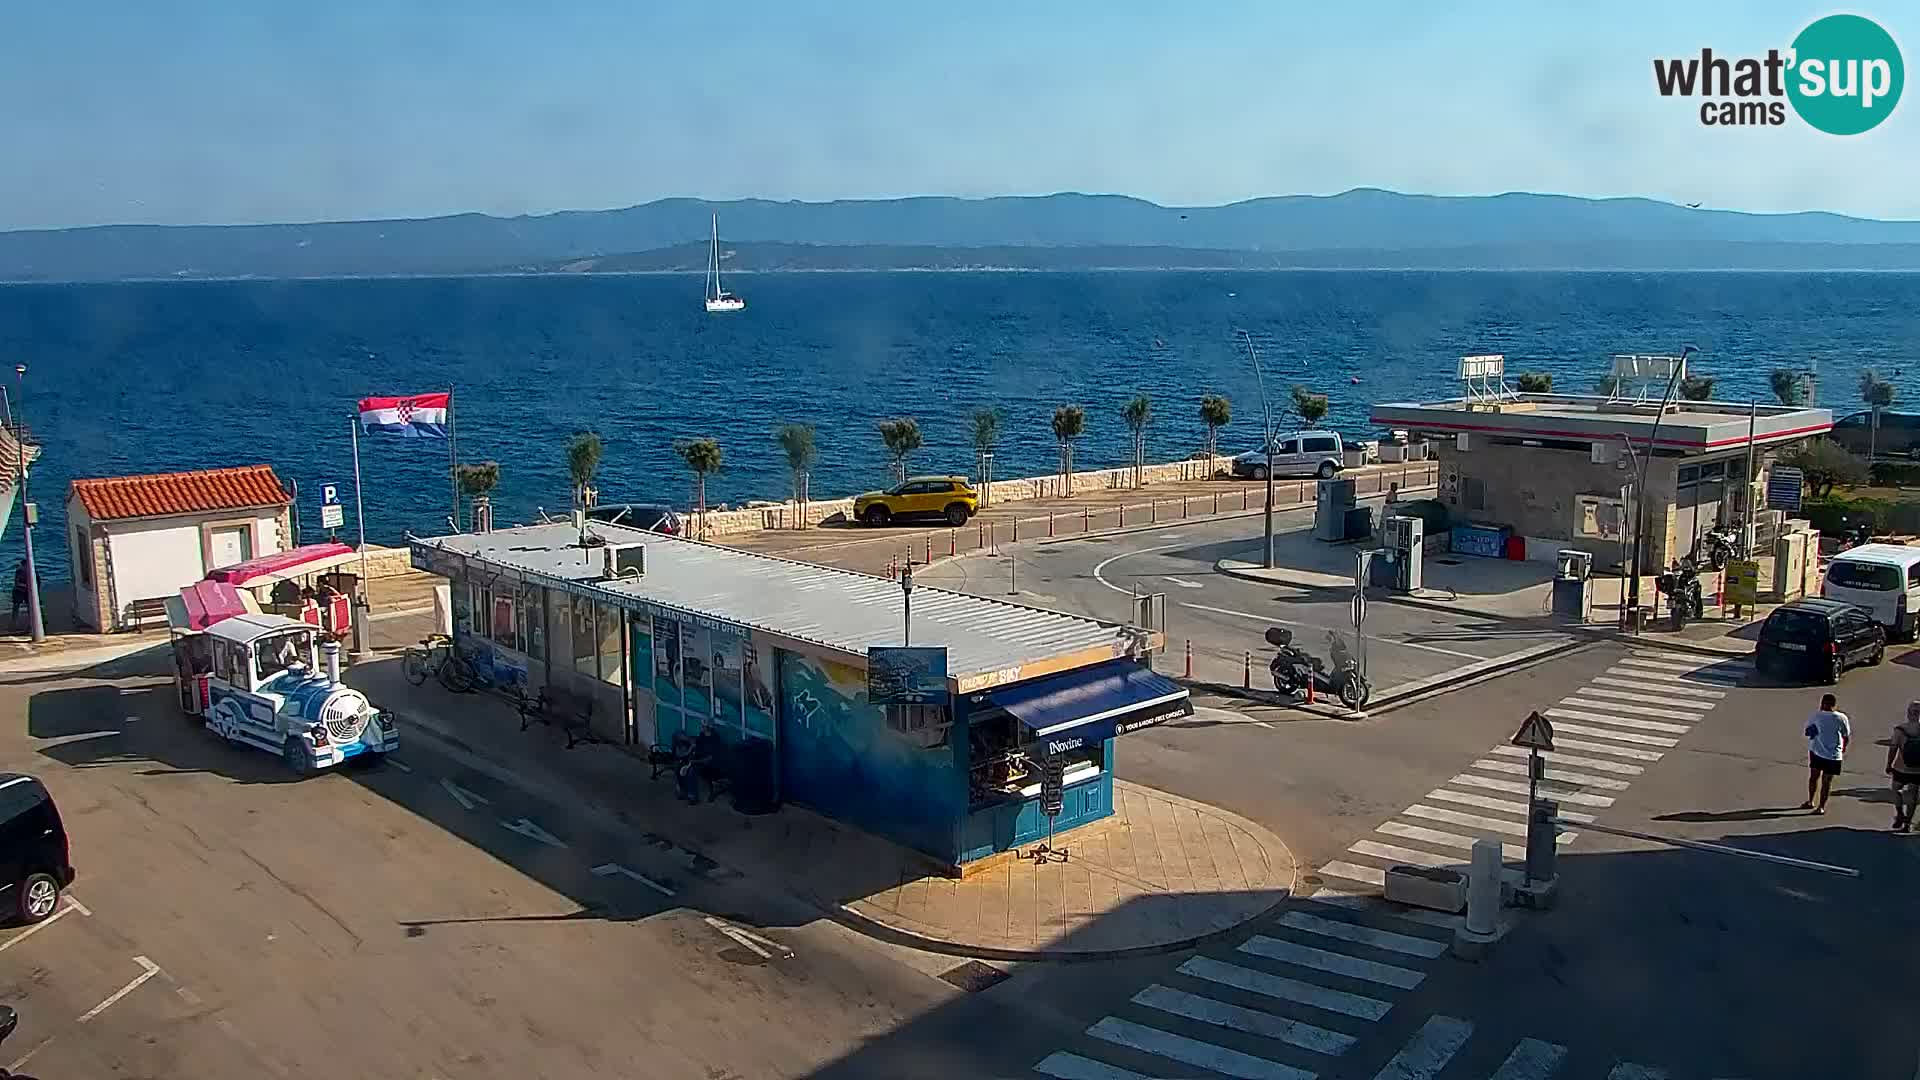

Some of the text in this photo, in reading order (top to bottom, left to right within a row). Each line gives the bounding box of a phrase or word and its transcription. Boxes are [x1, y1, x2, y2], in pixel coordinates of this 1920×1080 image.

[324, 485, 337, 504] P
[662, 608, 693, 624] STATION
[696, 616, 720, 631] TICKET
[721, 621, 747, 637] OFFICE
